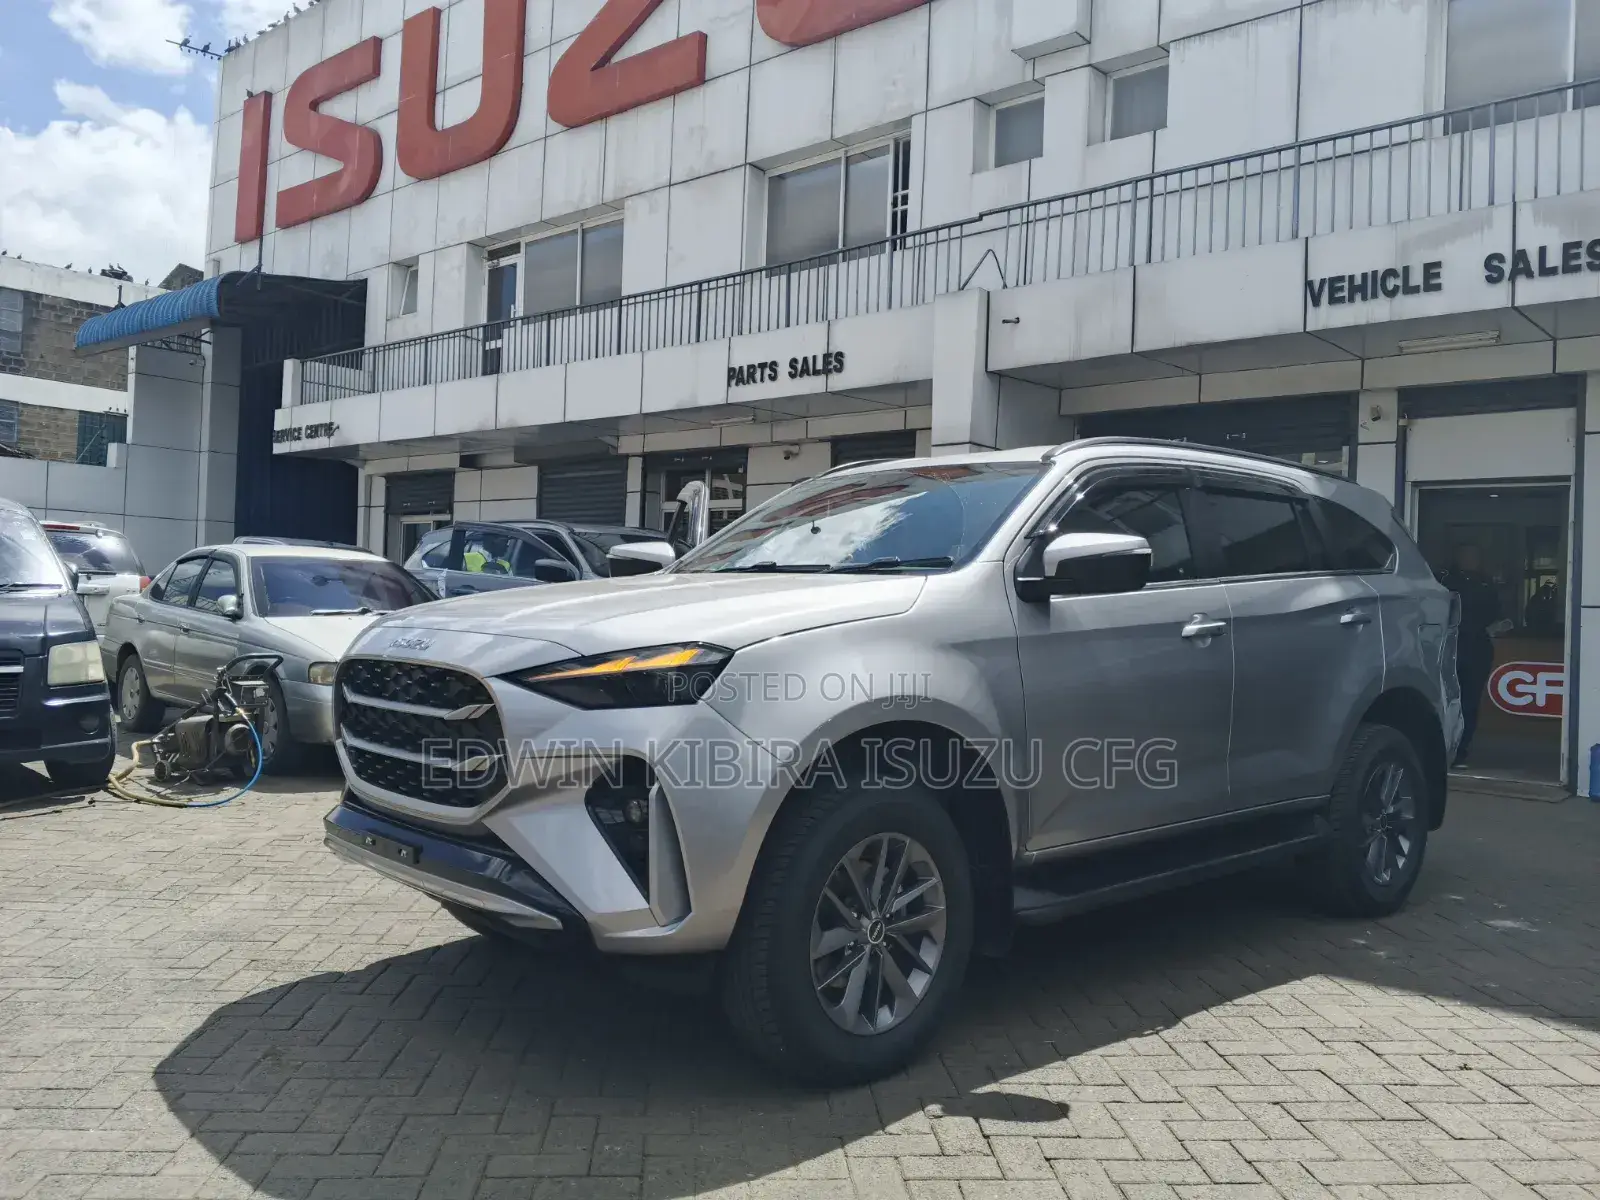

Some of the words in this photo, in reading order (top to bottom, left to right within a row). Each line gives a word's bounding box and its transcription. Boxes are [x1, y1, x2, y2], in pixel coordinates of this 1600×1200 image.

[235, 0, 932, 243] ISUZ
[1306, 261, 1443, 308] VEHICLE
[1483, 238, 1600, 285] SALES
[727, 360, 779, 387] PARTS
[788, 351, 845, 379] SALES
[272, 427, 303, 443] SERVICE
[305, 421, 335, 439] CENTRE
